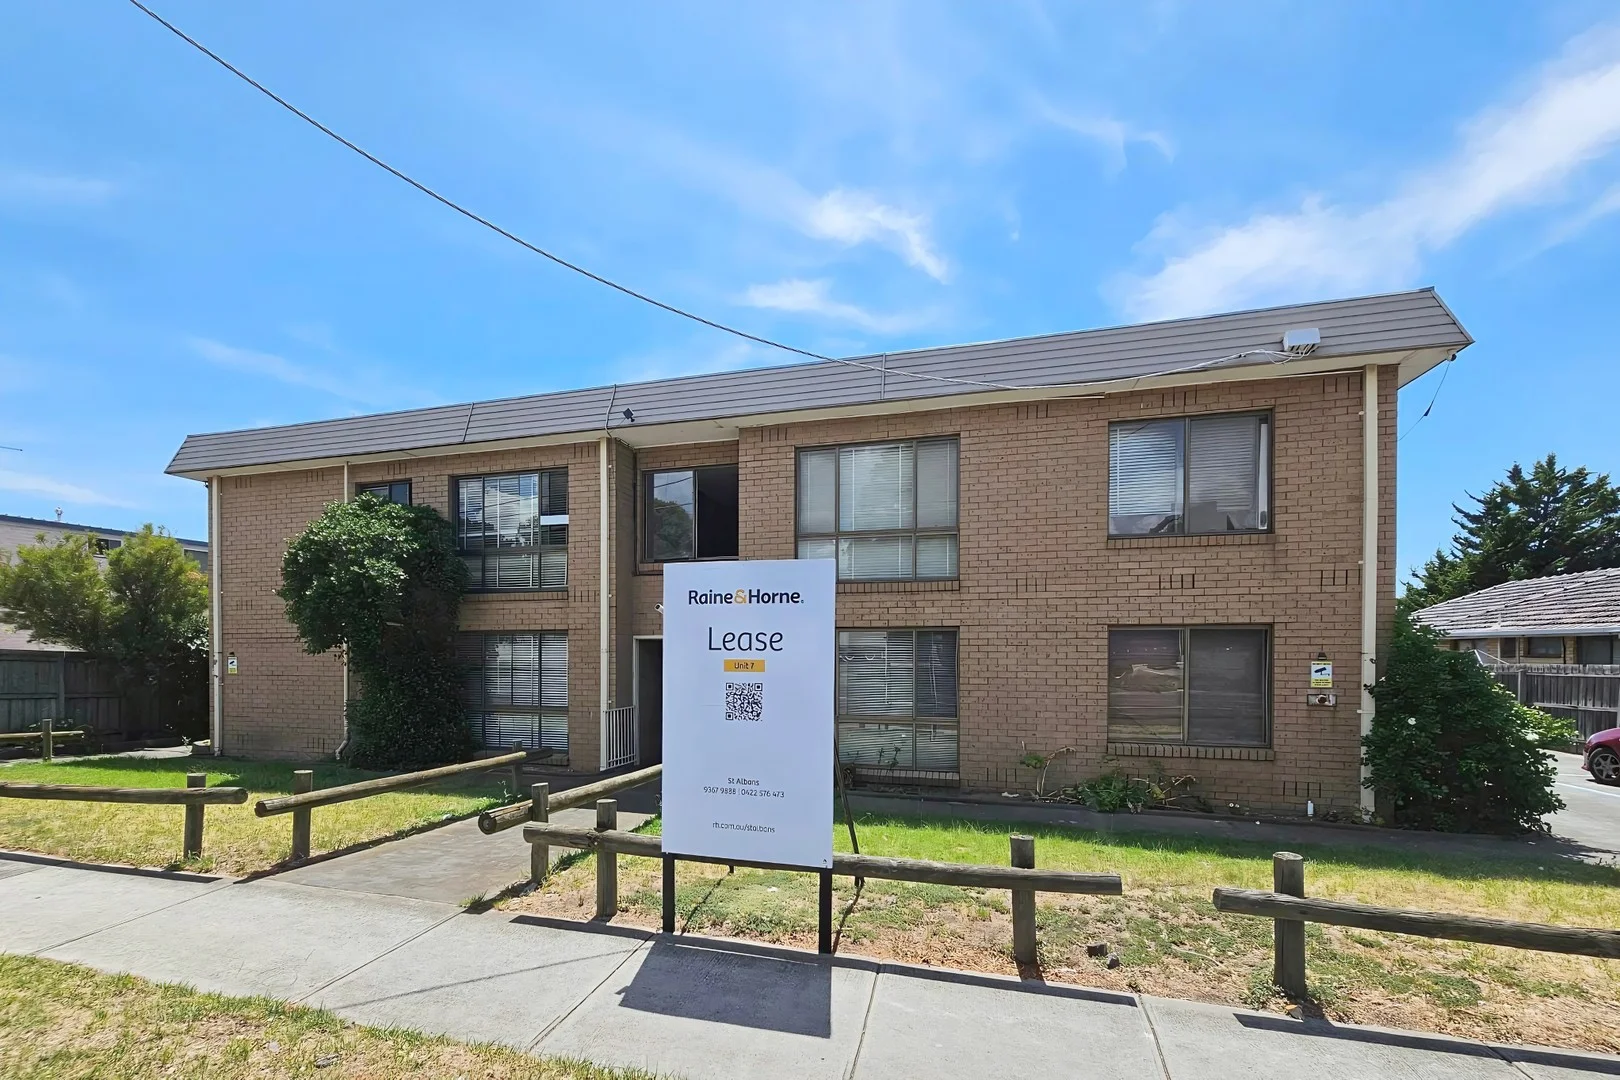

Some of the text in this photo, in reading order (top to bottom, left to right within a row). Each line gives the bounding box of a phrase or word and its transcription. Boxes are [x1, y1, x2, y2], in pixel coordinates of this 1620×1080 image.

[709, 627, 783, 652] Lease
[734, 662, 755, 670] Unit 7
[728, 777, 760, 786] St Albans
[704, 786, 719, 794] 9367
[759, 789, 771, 798] 576
